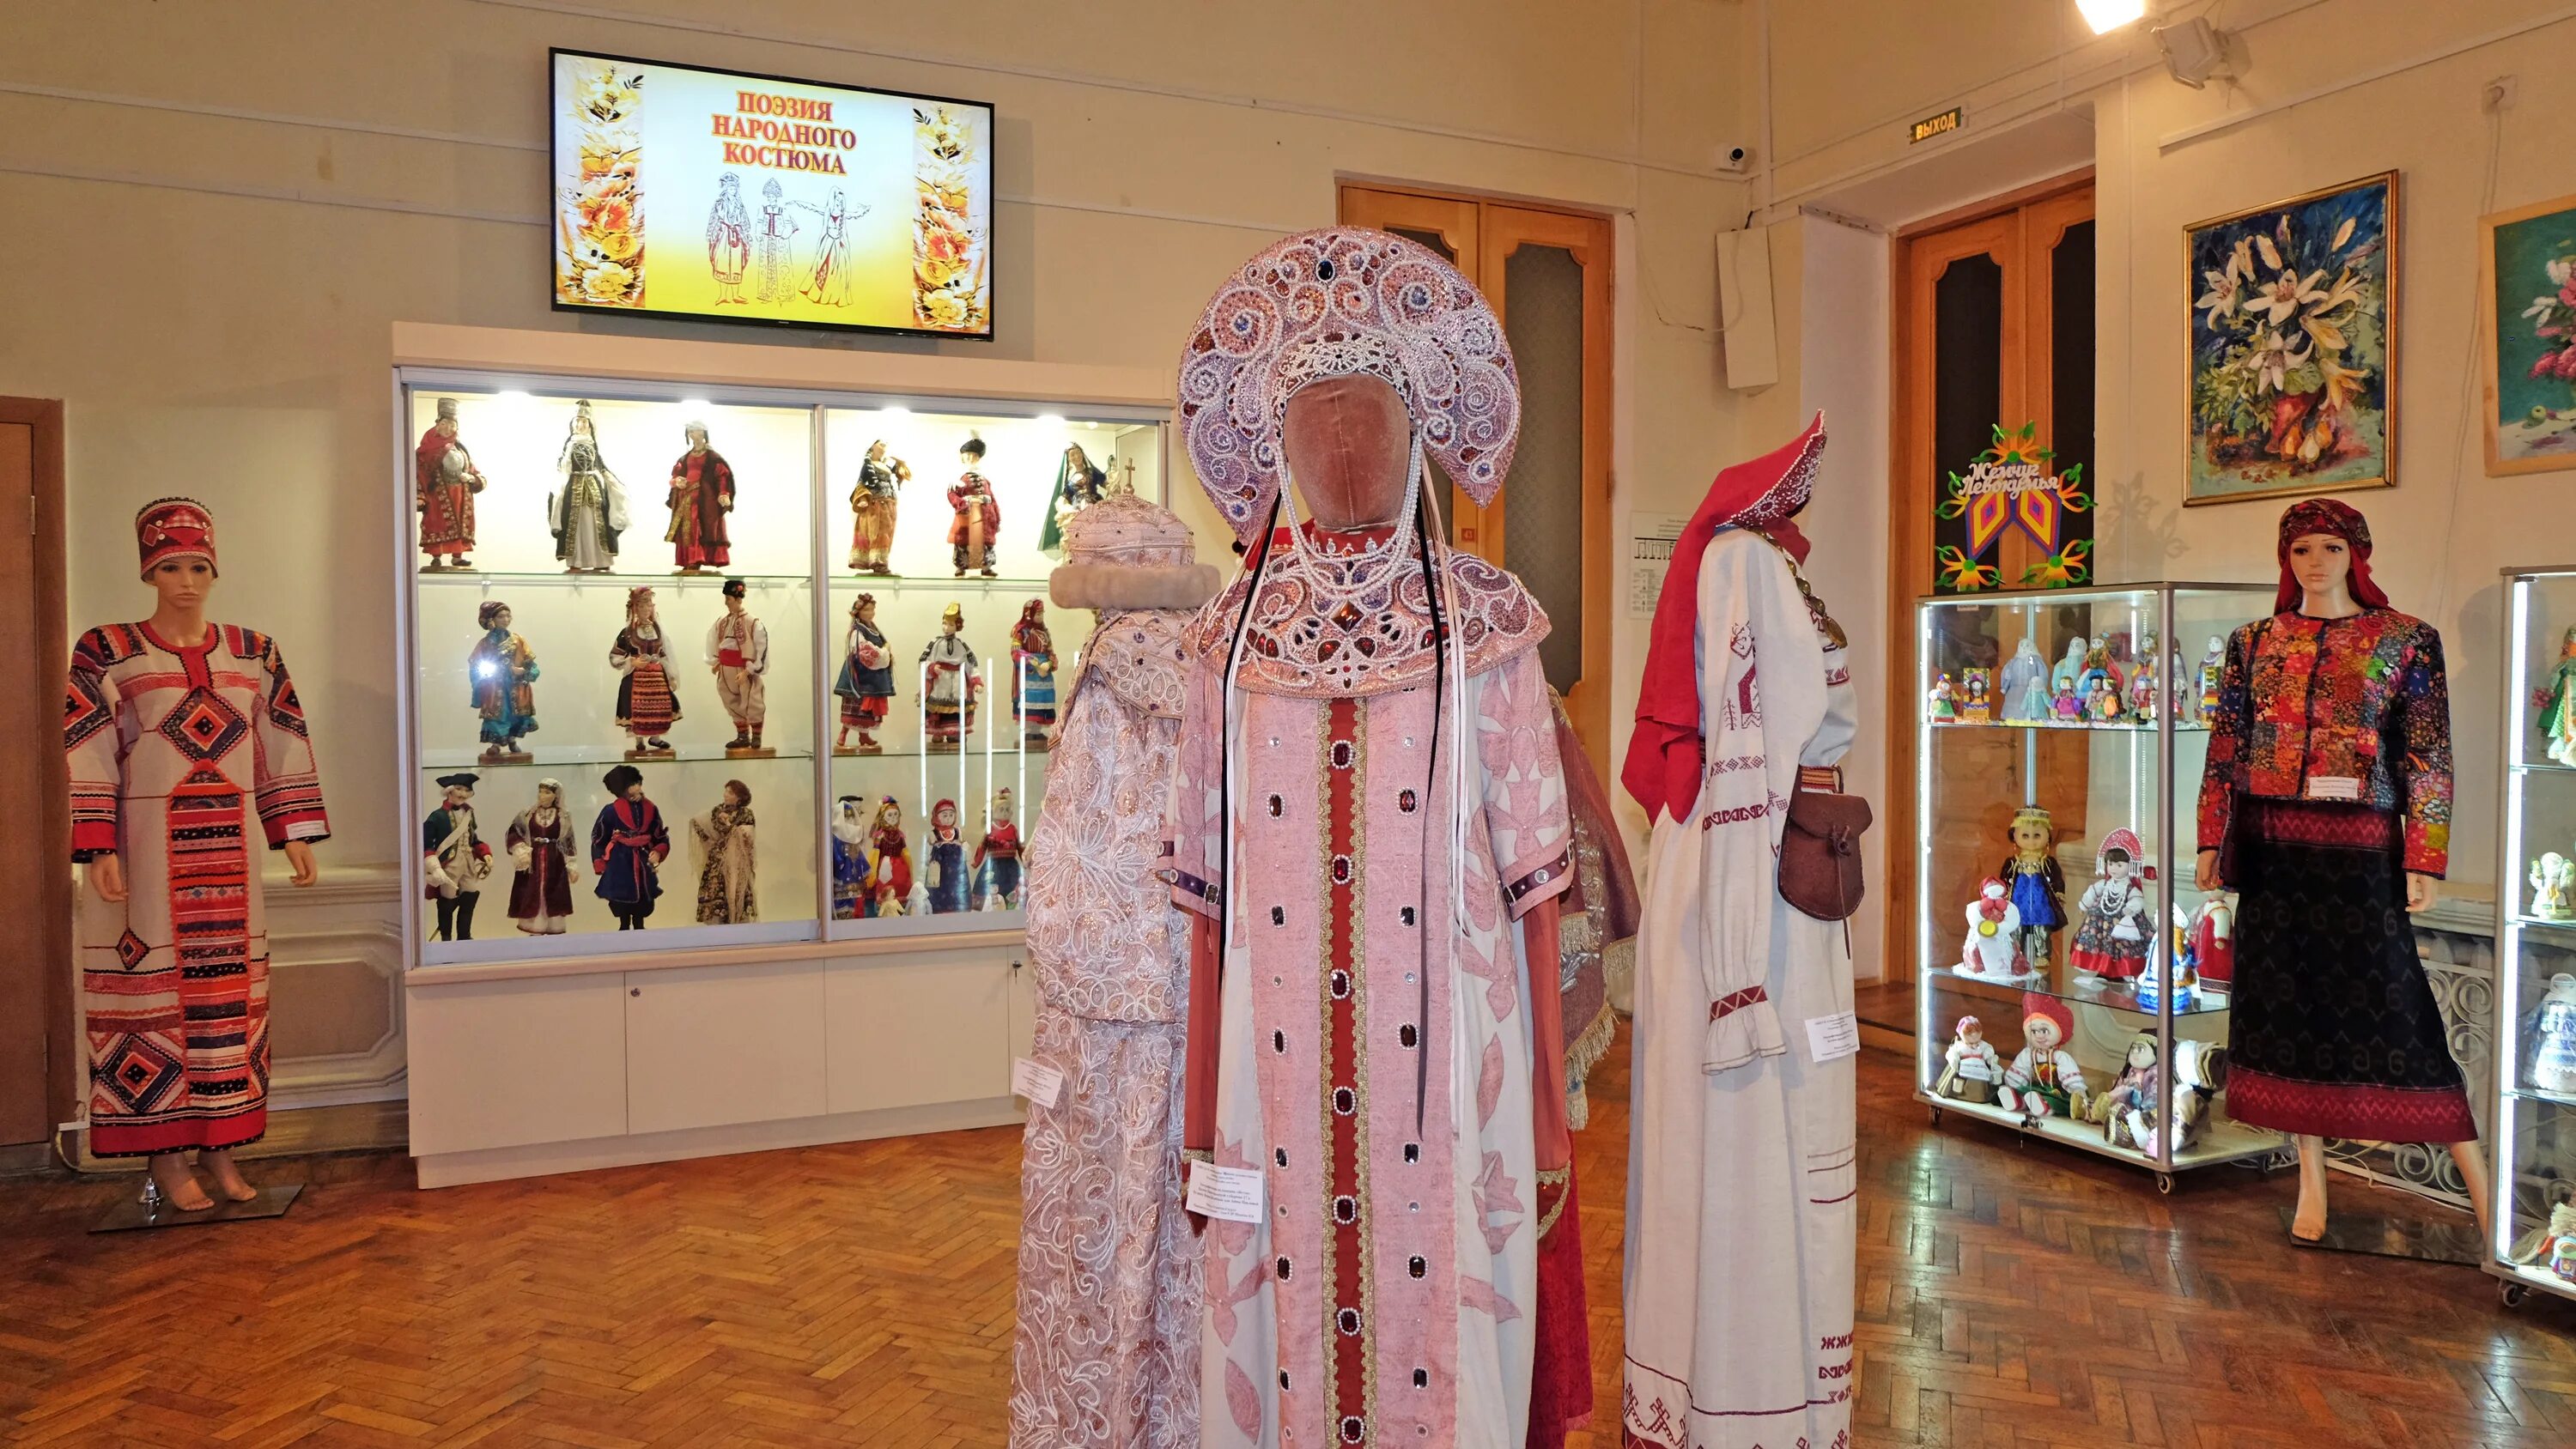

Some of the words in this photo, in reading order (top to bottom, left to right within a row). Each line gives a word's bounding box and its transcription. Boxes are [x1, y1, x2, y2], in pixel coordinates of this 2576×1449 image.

[736, 90, 834, 123] ПОЭЗИЯ
[711, 113, 857, 151] НАРОДНОГО
[1916, 112, 1956, 140] ВЫХОД
[723, 142, 847, 176] КОСТЮМА
